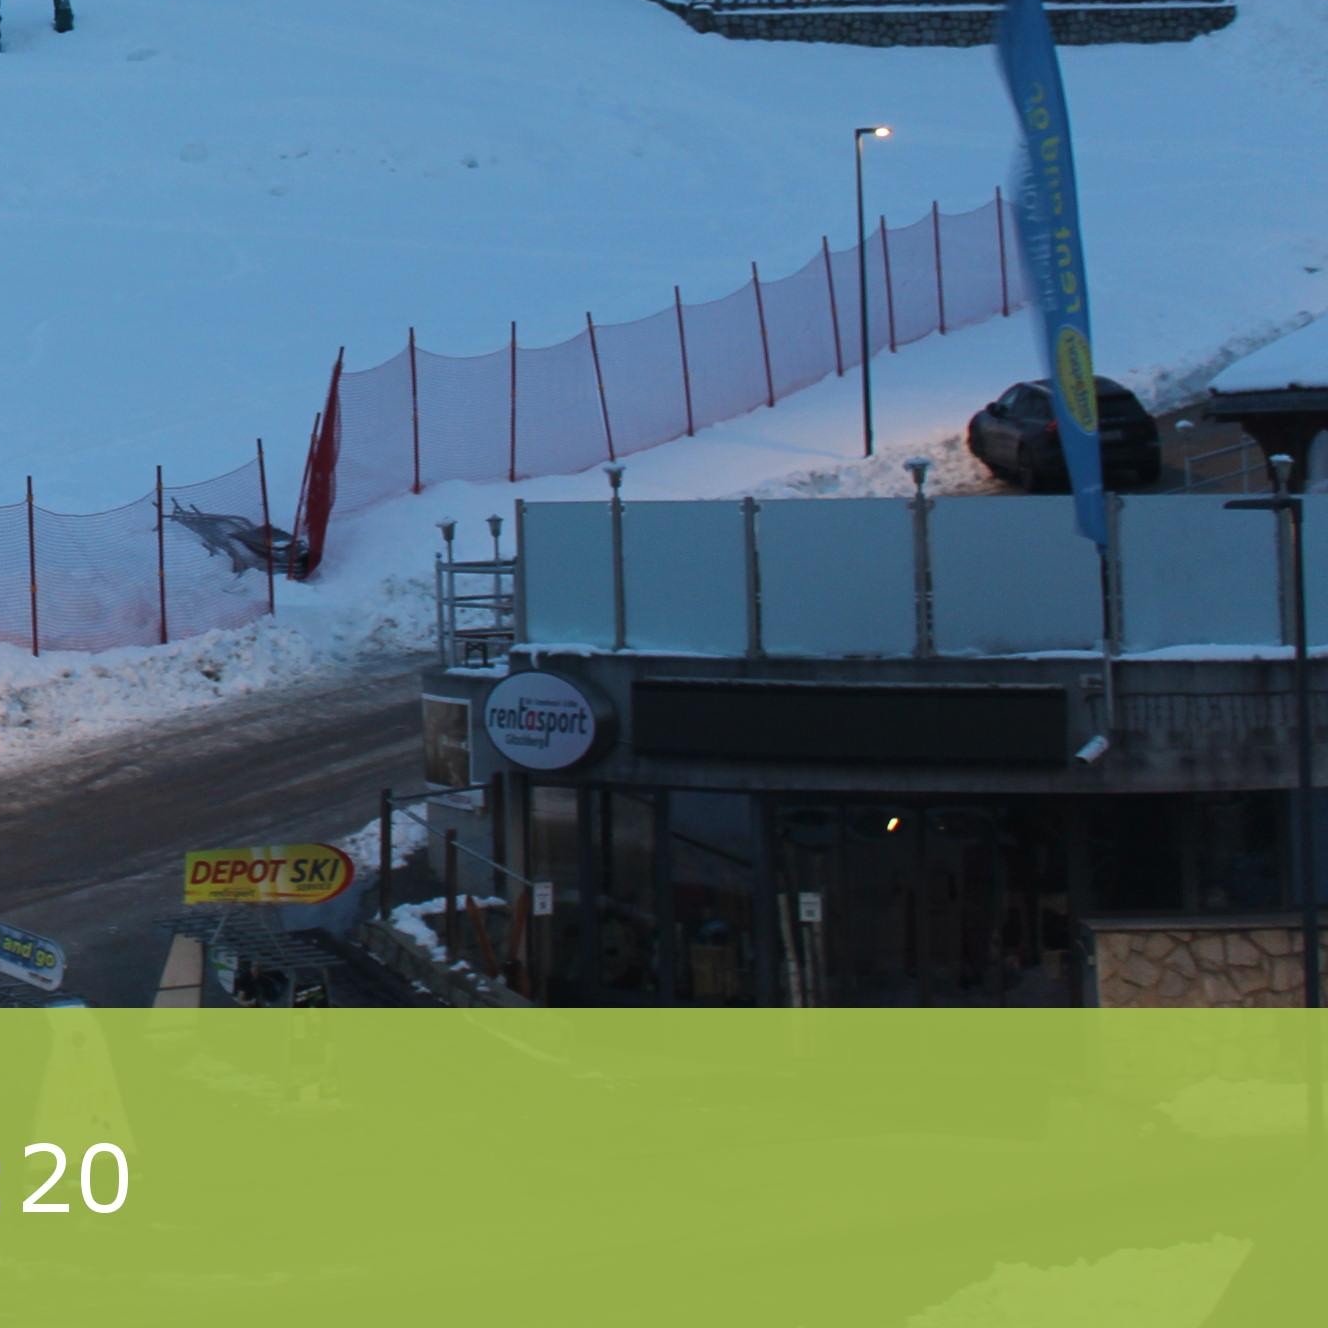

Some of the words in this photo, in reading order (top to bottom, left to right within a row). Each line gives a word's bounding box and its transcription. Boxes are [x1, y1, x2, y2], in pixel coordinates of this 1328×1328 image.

[489, 697, 587, 748] rentasport
[191, 859, 286, 884] DEPOT
[290, 859, 339, 882] SKI
[2, 936, 33, 959] and
[35, 949, 56, 969] go
